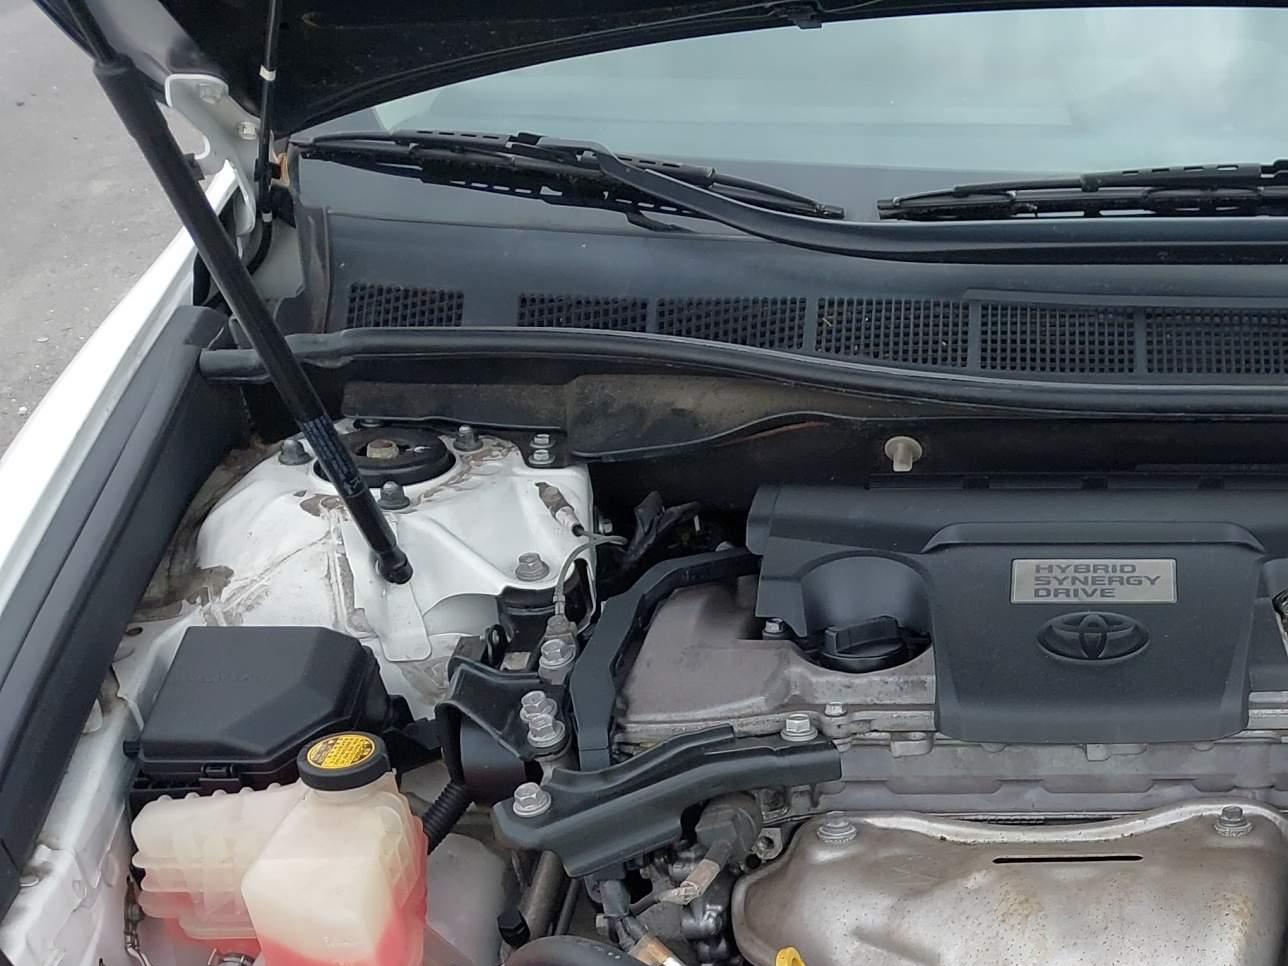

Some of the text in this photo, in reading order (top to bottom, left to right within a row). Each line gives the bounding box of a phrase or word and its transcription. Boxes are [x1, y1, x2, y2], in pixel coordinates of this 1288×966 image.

[1034, 564, 1136, 574] HYBRID
[1034, 575, 1161, 586] SYNERGY
[1034, 587, 1116, 598] DRIVE
